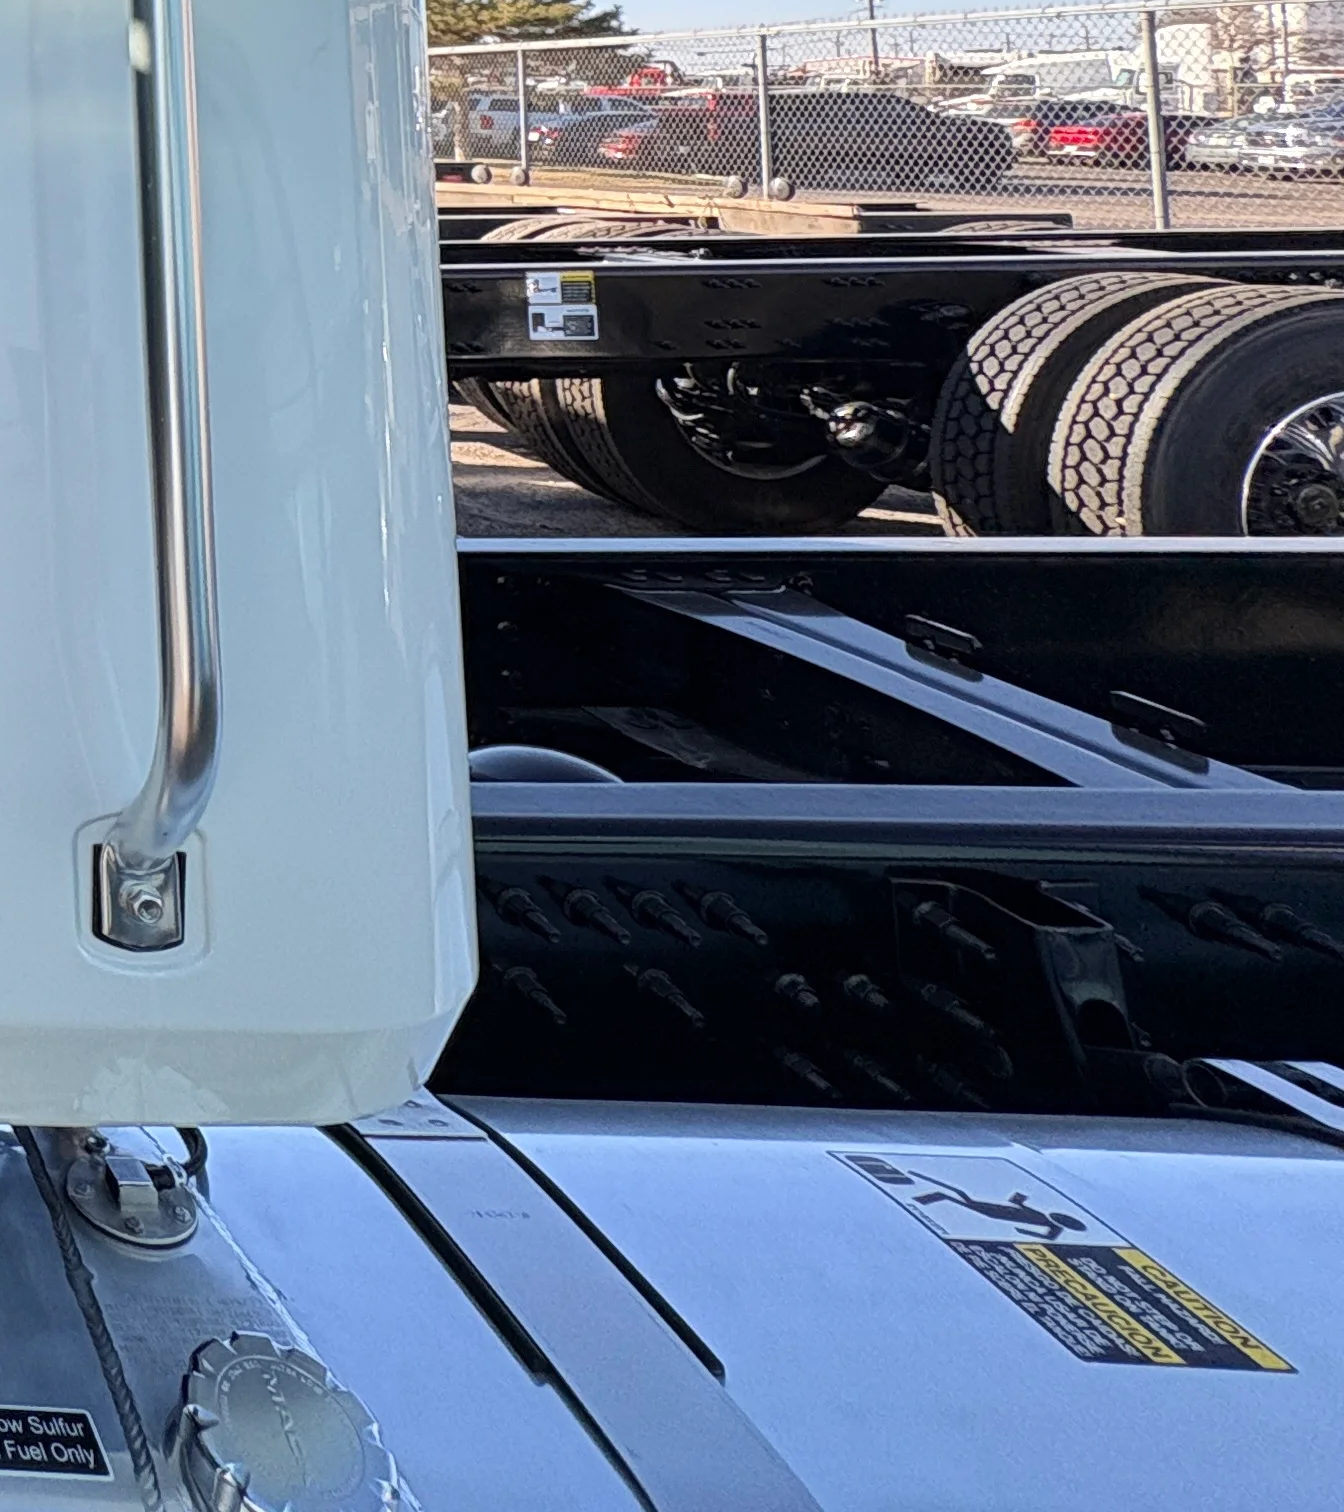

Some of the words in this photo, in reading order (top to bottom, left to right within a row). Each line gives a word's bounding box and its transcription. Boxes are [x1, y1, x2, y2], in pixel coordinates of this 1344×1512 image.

[1136, 1265, 1265, 1350] CAUTION
[27, 1415, 85, 1437] Sulfur
[4, 1440, 48, 1461] Fuel
[51, 1442, 95, 1469] Only
